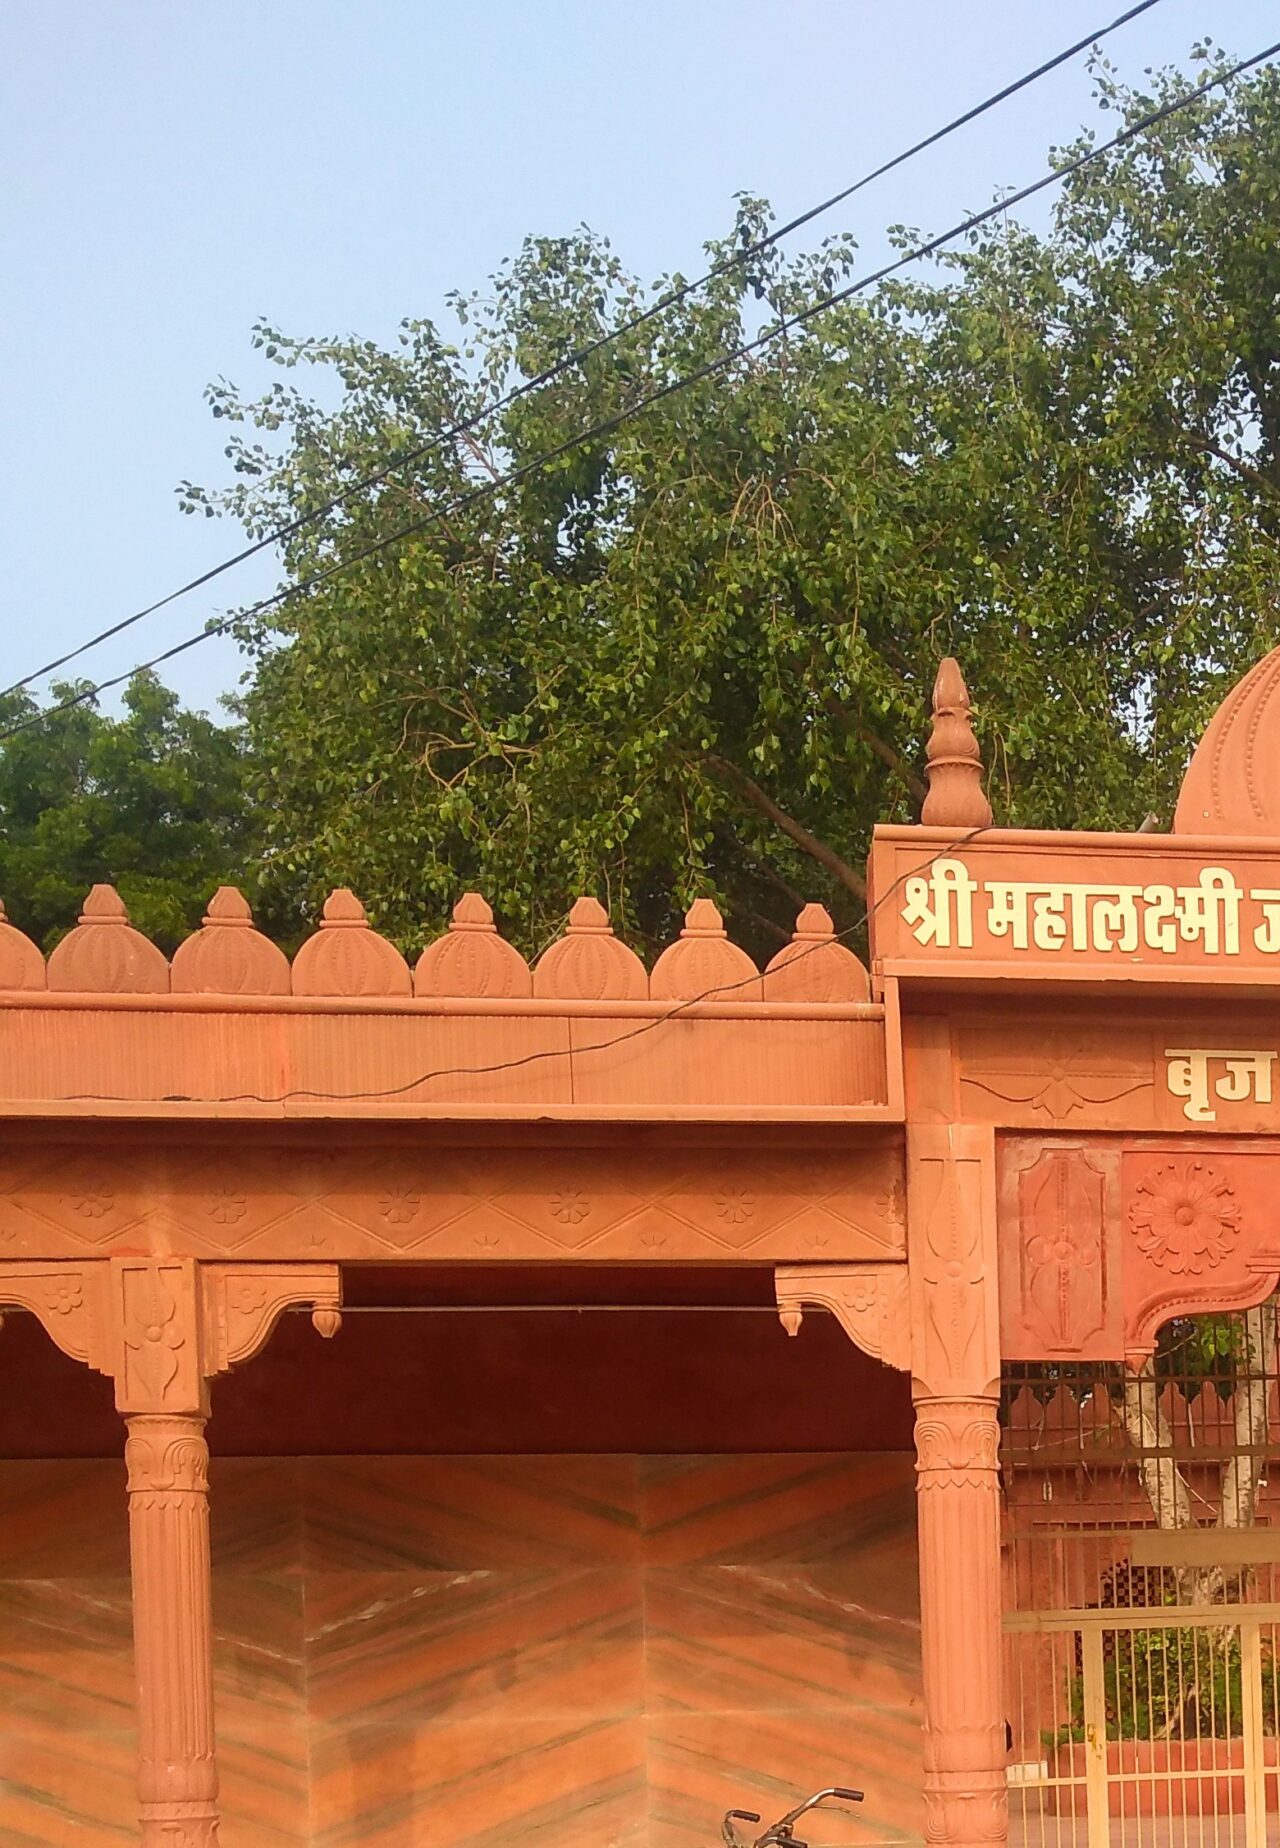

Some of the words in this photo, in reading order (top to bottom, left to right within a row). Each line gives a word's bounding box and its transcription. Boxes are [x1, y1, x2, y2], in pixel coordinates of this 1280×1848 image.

[900, 858, 978, 948] श्री
[984, 866, 1243, 955] महालक्ष्मी
[1165, 1048, 1279, 1122] बृज
